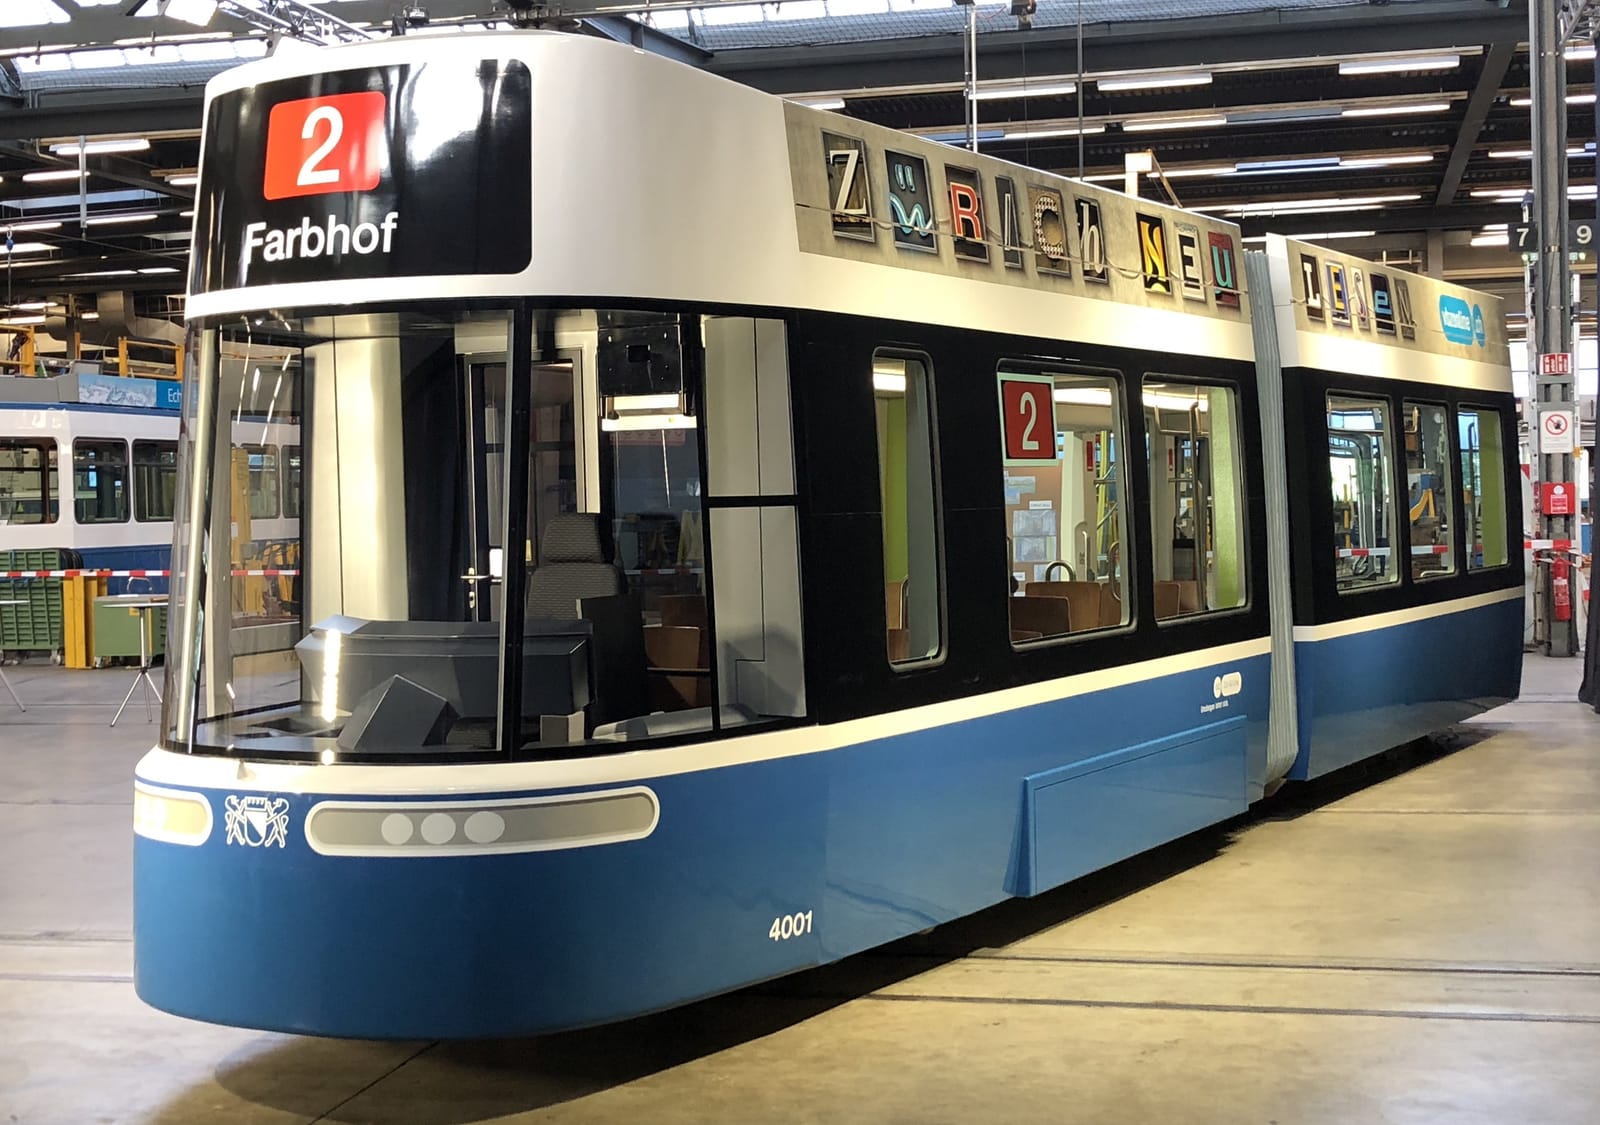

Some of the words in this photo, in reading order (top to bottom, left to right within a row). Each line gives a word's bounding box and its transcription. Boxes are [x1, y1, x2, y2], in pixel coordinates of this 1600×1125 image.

[296, 105, 345, 187] 2
[245, 211, 400, 266] Farbhof
[1516, 227, 1530, 247] 7
[1575, 224, 1593, 245] 9
[1019, 391, 1040, 451] 2
[768, 909, 813, 942] 4001
